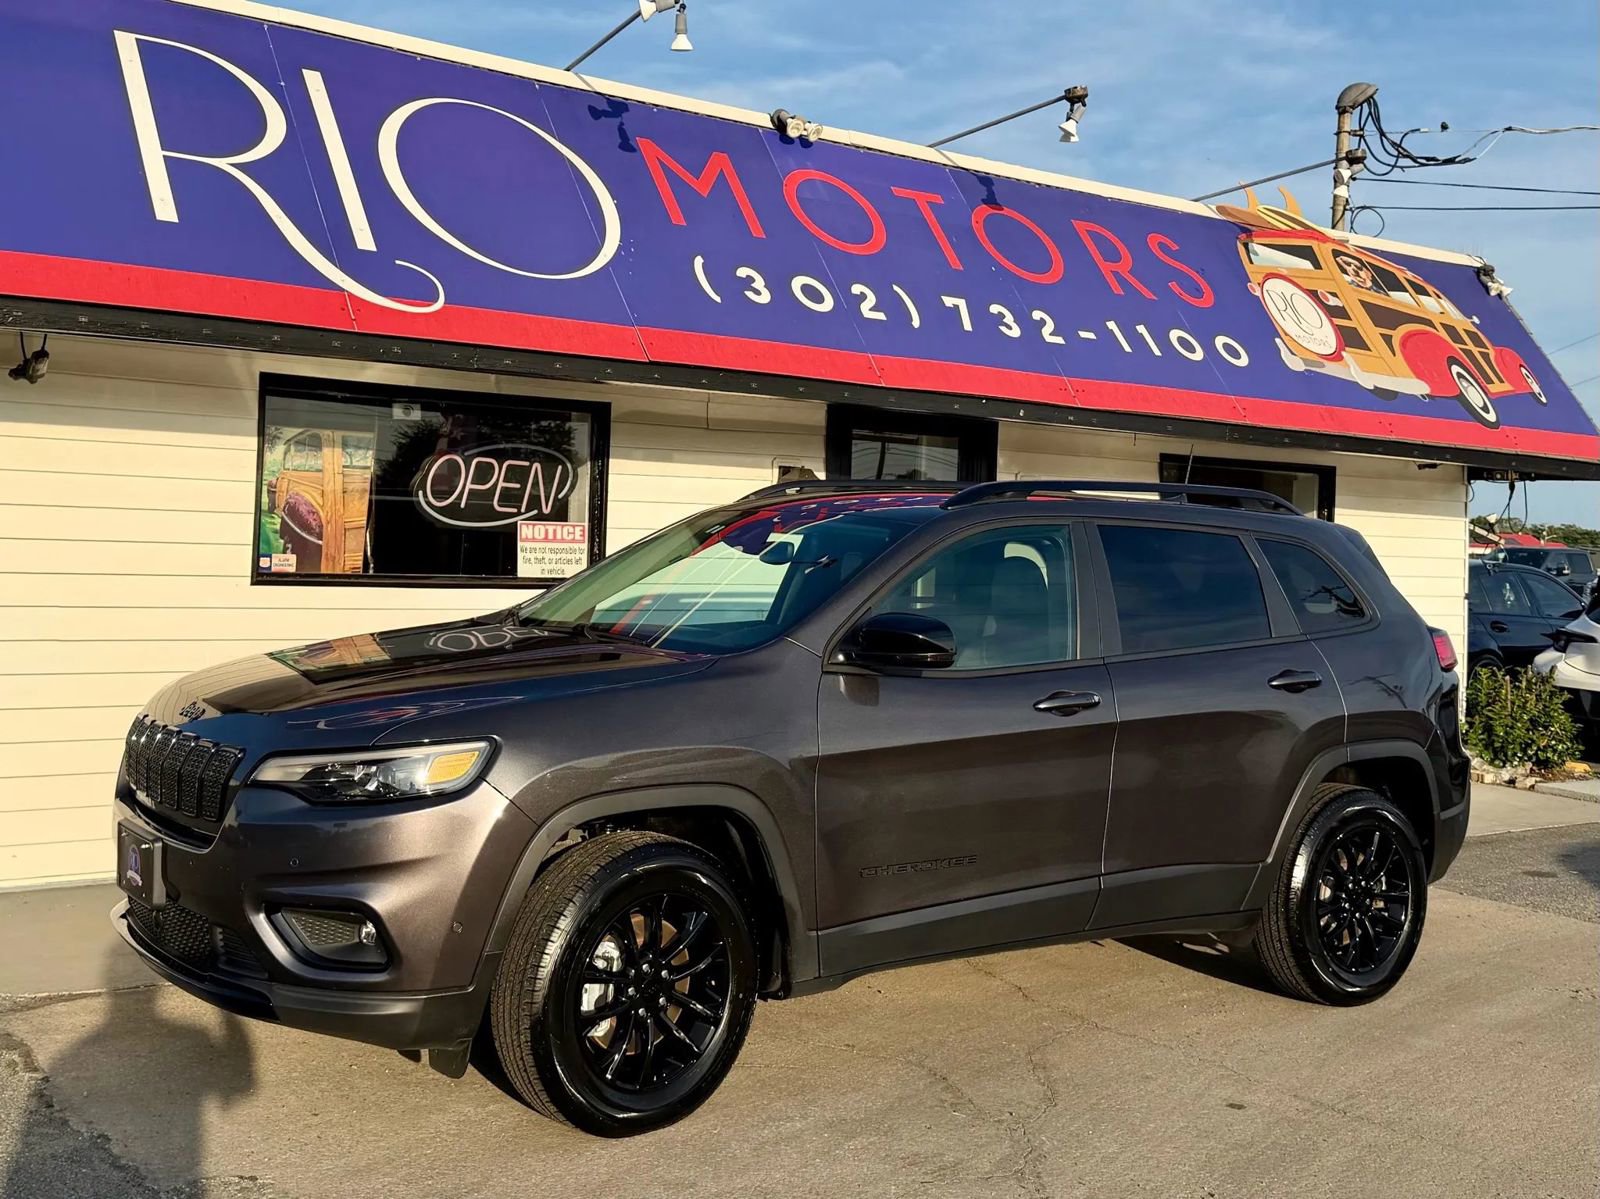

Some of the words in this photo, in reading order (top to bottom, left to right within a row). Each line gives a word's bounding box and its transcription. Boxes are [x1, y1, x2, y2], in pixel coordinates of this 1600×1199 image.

[113, 30, 622, 314] RIO
[636, 137, 1215, 308] MOTORS
[694, 255, 920, 329] (302)
[941, 295, 1249, 367] 732-1100
[1266, 289, 1323, 336] RIO
[426, 453, 562, 514] OPEN
[521, 524, 584, 541] NOTICE
[529, 546, 537, 554] are
[538, 546, 547, 554] not
[548, 546, 577, 556] responsible
[555, 557, 573, 565] articles
[574, 557, 582, 566] left
[860, 854, 977, 878] CHEROKEE
